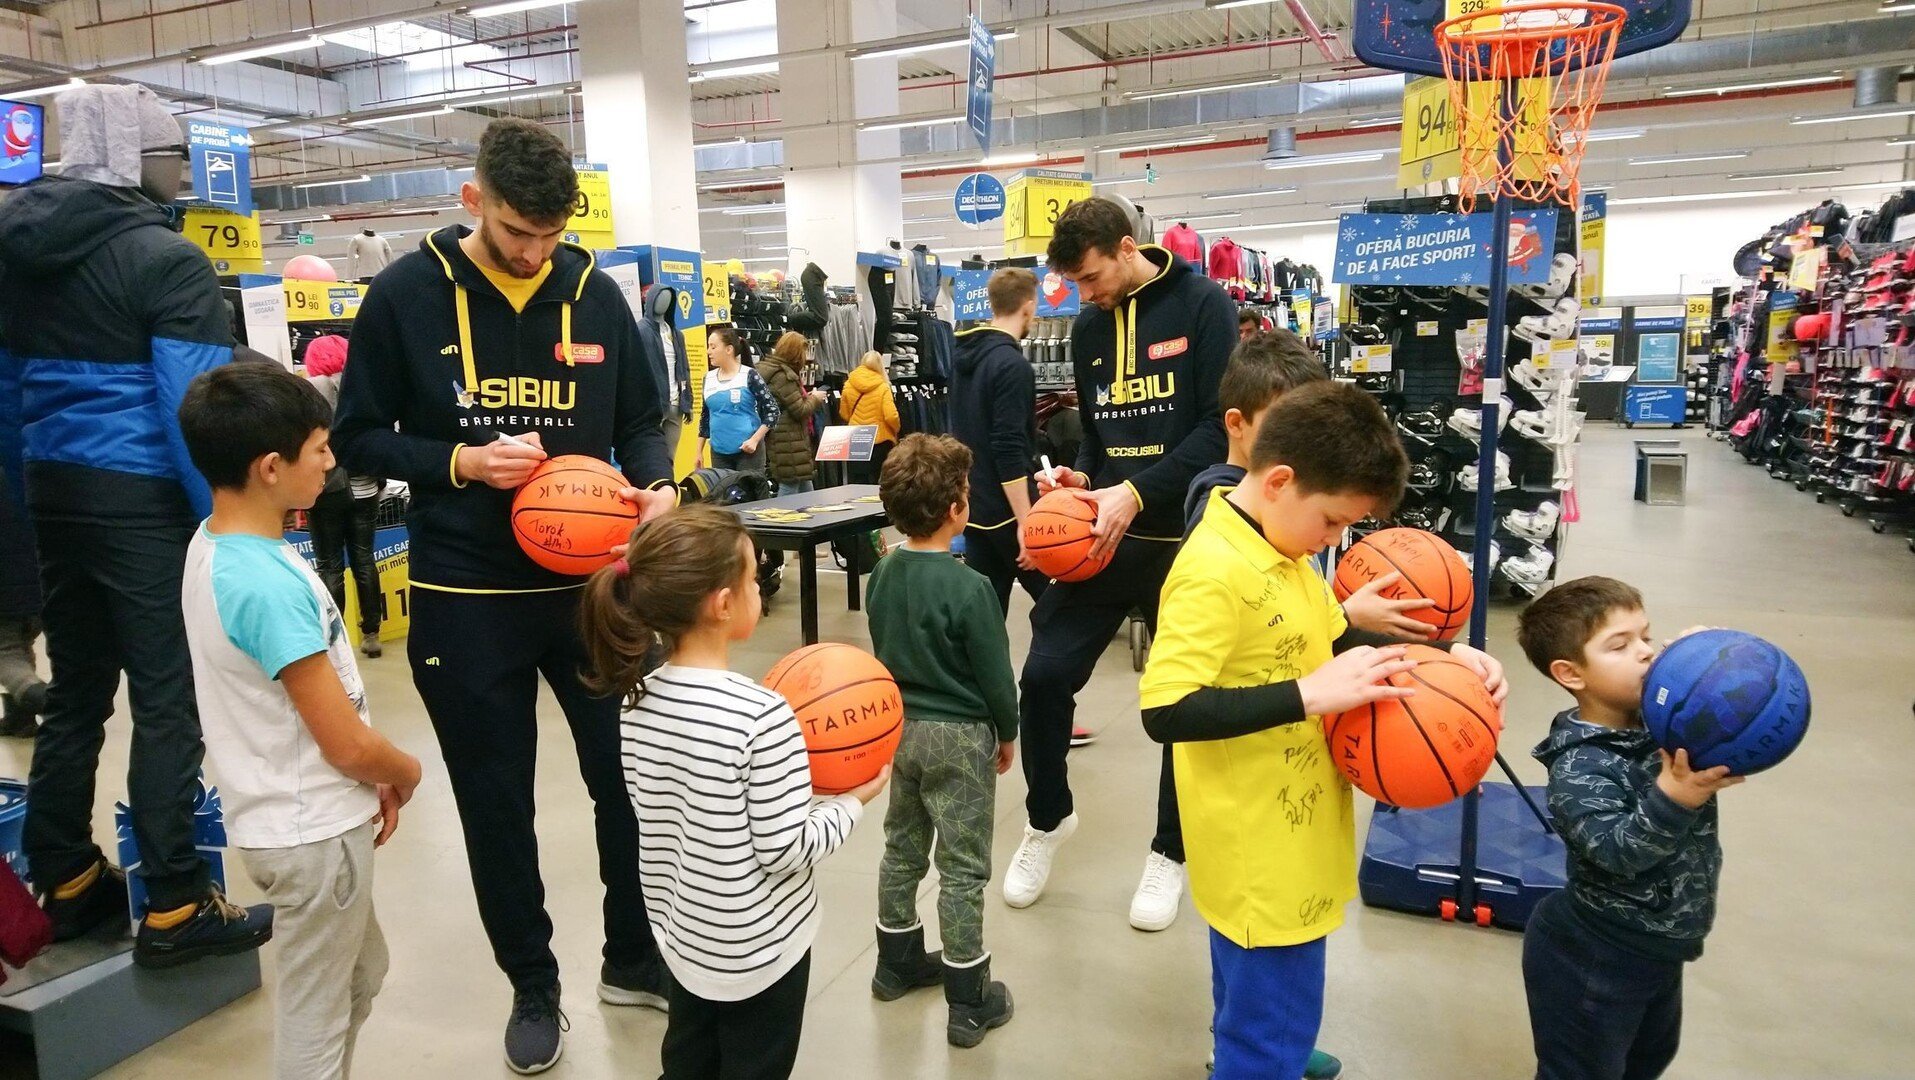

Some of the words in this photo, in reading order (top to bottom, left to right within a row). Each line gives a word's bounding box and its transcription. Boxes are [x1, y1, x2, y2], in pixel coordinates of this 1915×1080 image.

[1461, 1, 1484, 14] 329
[1420, 99, 1446, 142] 94
[190, 124, 230, 138] CABINE
[191, 136, 203, 144] DE
[201, 225, 240, 248] 79
[243, 240, 259, 249] 90
[1356, 234, 1403, 256] OFERĂ
[1406, 227, 1471, 250] BUCURIA
[1347, 260, 1367, 276] DE
[1368, 259, 1379, 273] A
[1382, 253, 1420, 271] FACE
[1422, 243, 1476, 265] SPORT!
[704, 277, 715, 297] 2
[716, 289, 725, 298] 90
[284, 291, 306, 309] 19
[309, 302, 319, 311] 90
[963, 303, 975, 314] DE
[976, 302, 982, 311] A
[480, 376, 577, 410] SIBIU
[1095, 402, 1174, 420] BASKETBALL
[459, 415, 575, 427] BASKETBALL
[805, 693, 899, 735] TARMAK
[1730, 682, 1801, 765] TARMAK
